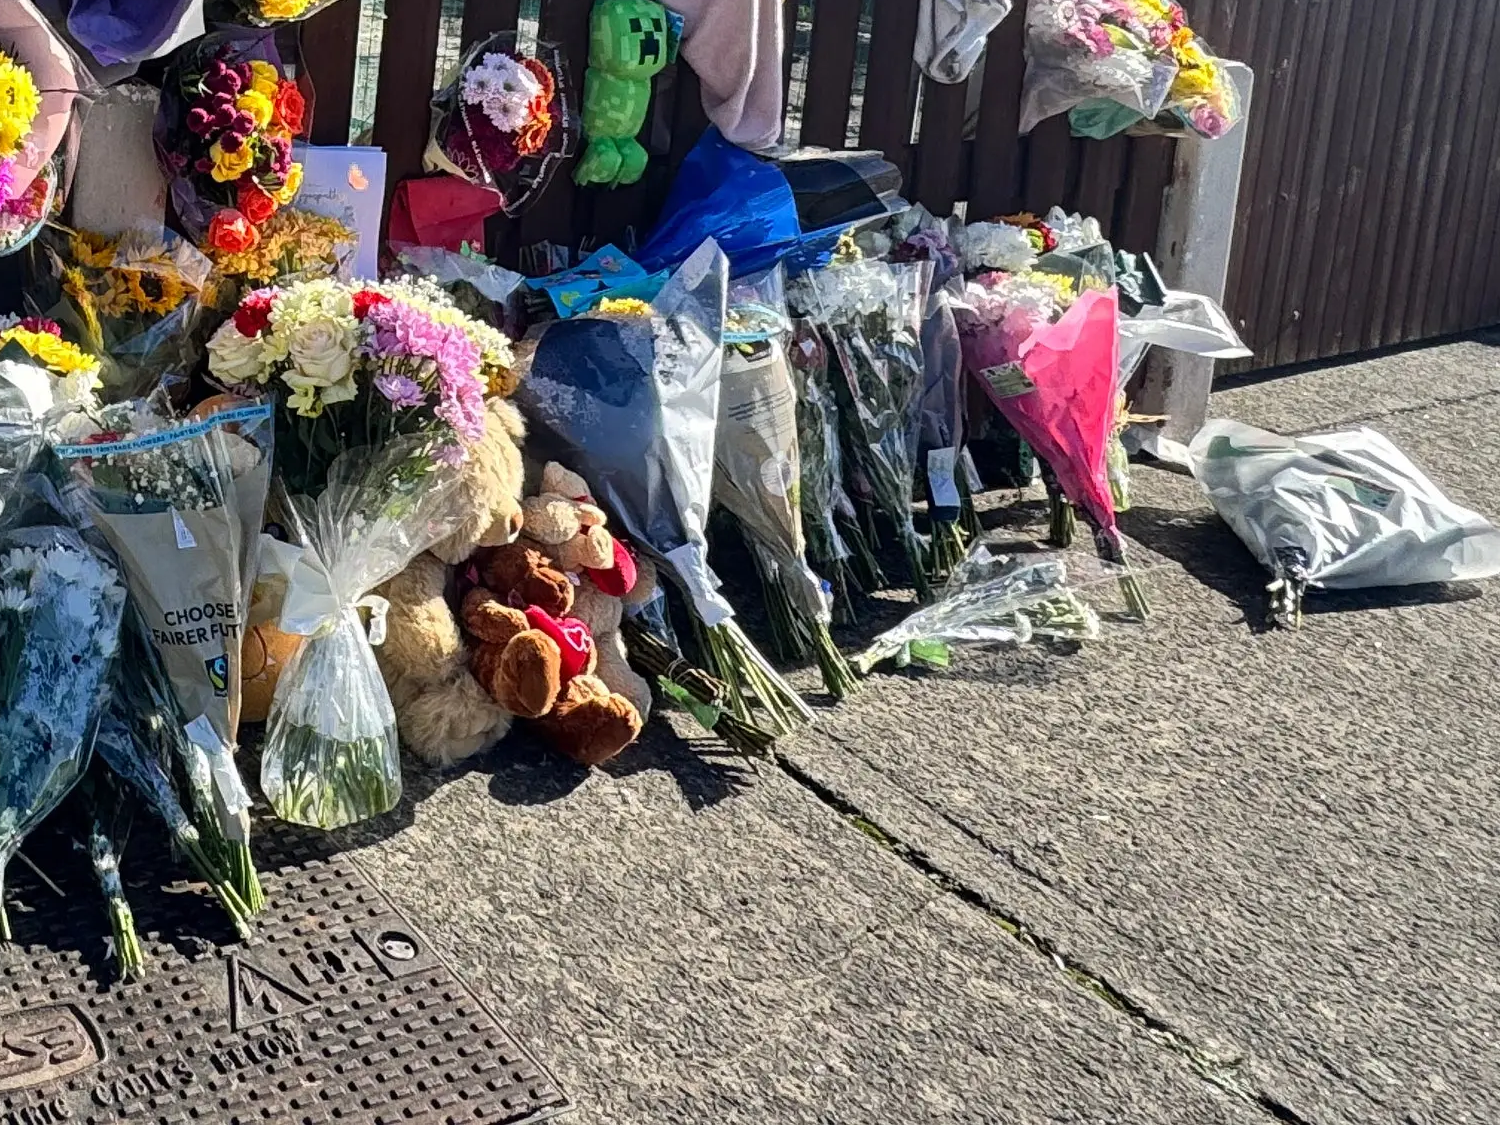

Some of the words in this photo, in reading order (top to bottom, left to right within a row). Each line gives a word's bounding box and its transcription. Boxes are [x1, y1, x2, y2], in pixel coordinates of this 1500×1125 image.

[164, 603, 236, 626] CHOOSE
[152, 628, 209, 646] FAIRER
[209, 1029, 302, 1075] BELOW
